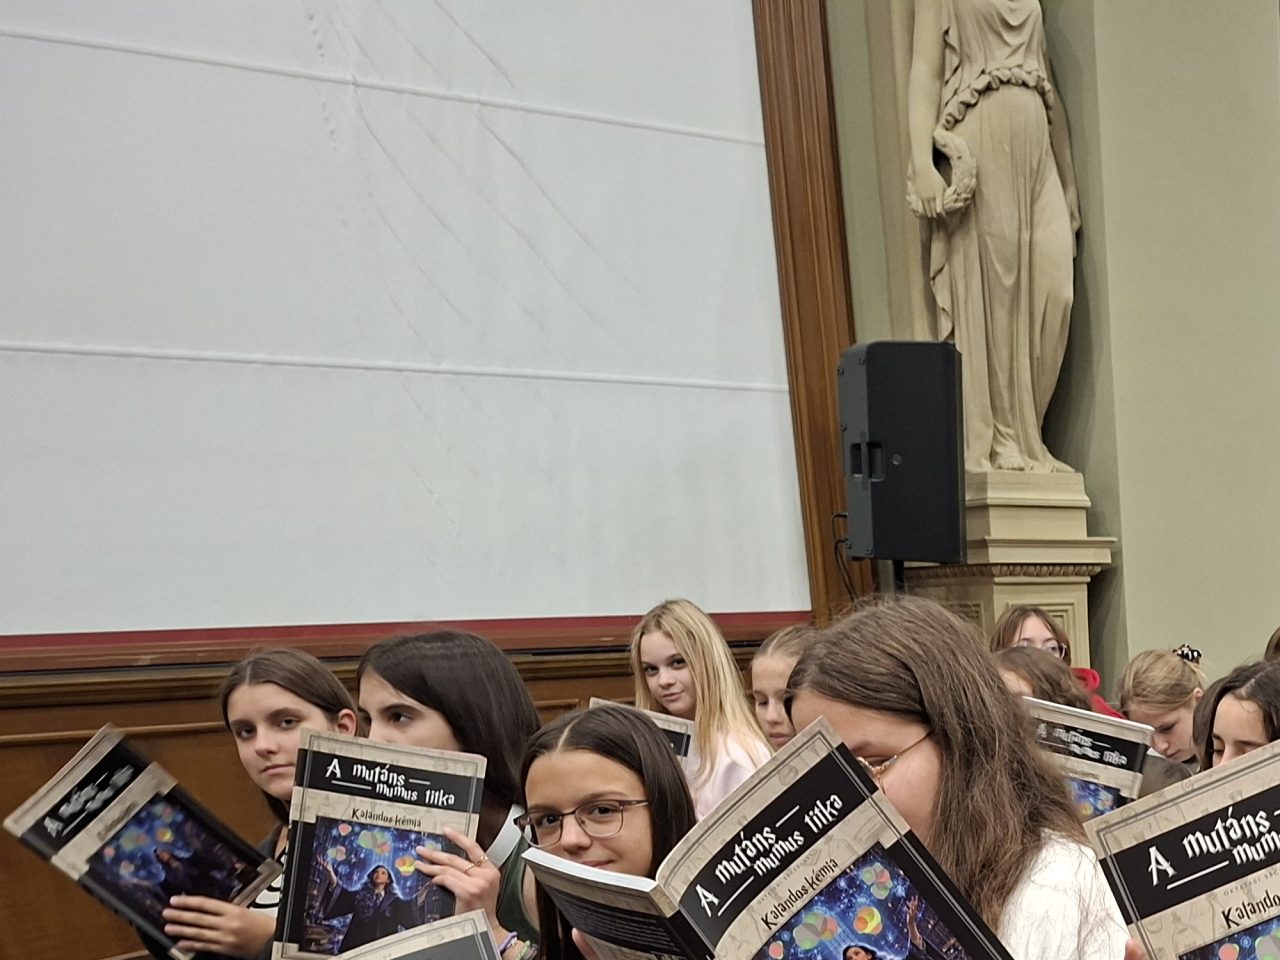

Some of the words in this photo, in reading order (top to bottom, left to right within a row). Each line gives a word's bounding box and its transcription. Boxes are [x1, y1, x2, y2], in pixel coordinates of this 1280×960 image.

[325, 758, 341, 778] A
[352, 764, 405, 786] mutáns
[376, 782, 418, 801] mumus
[425, 789, 455, 806] titka
[351, 808, 393, 823] Kalandos
[753, 830, 804, 877] mumus
[804, 794, 843, 833] titka
[1148, 845, 1177, 886] A
[1182, 806, 1271, 859] mutáns
[695, 884, 721, 918] A
[714, 827, 776, 884] mutáns
[761, 886, 809, 930] Kalandos
[805, 858, 839, 891] kémia
